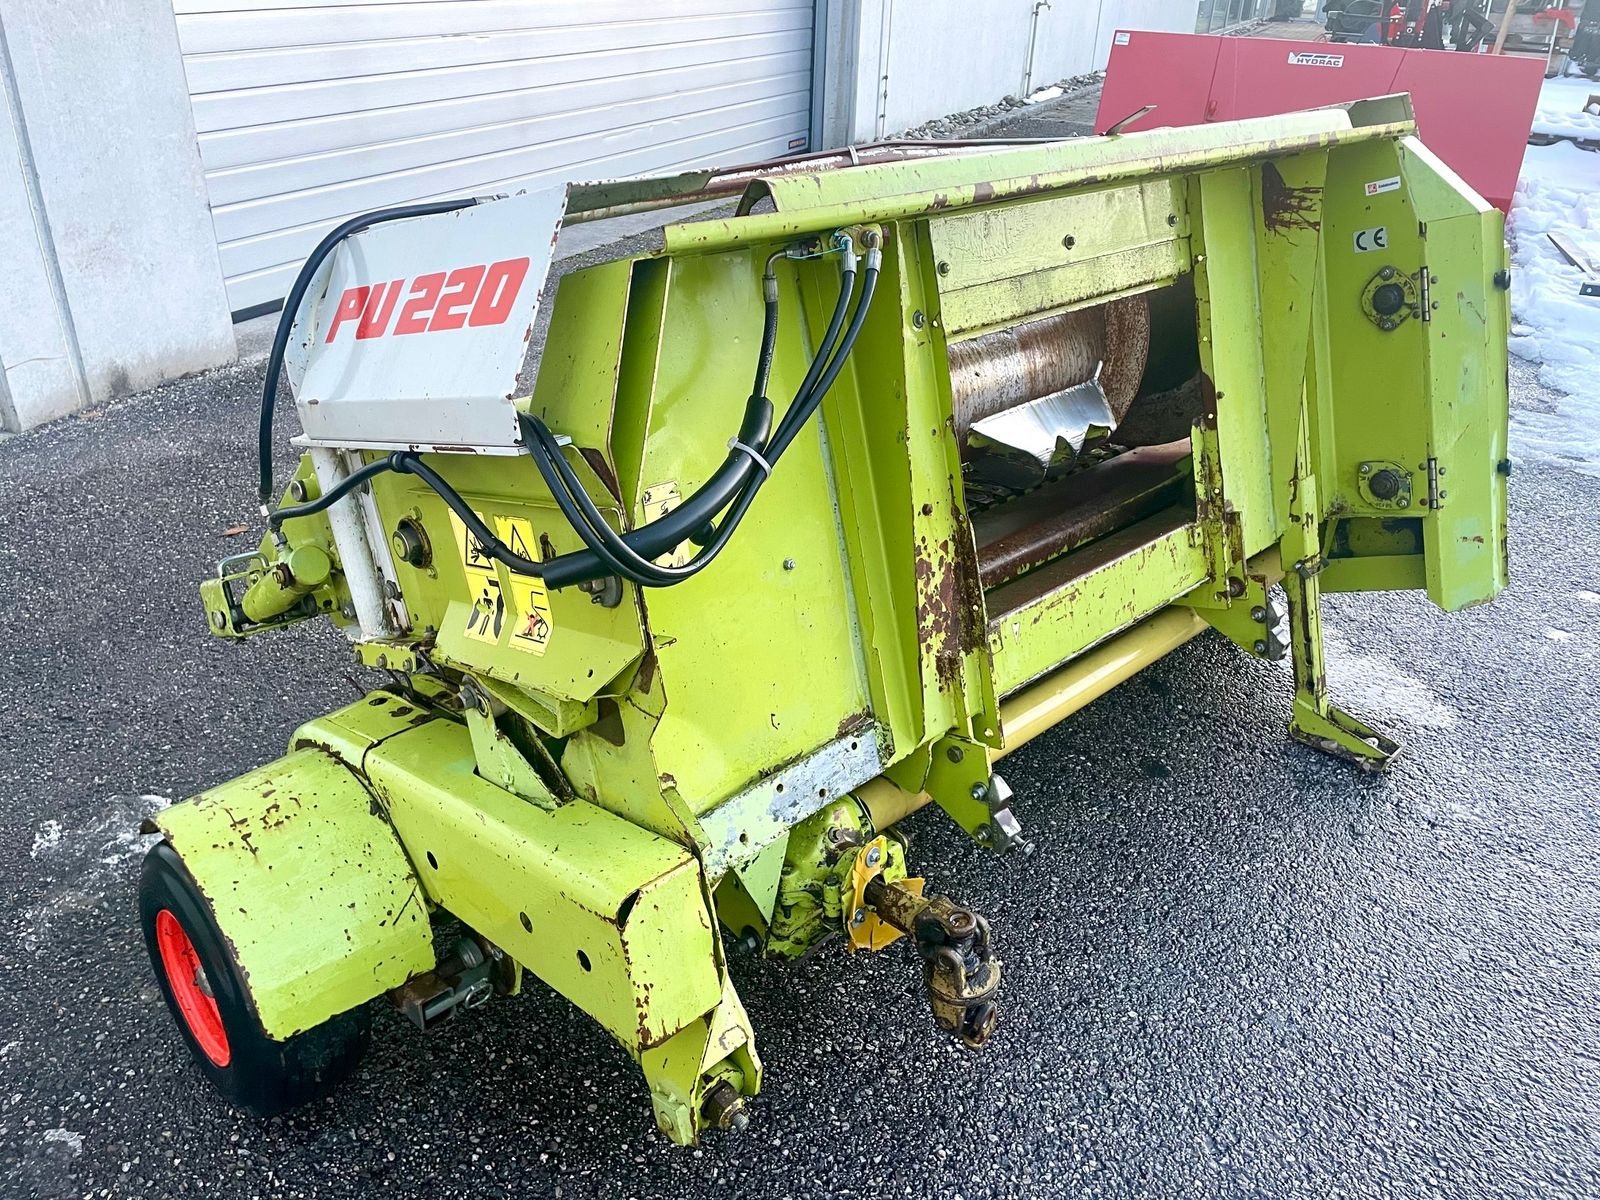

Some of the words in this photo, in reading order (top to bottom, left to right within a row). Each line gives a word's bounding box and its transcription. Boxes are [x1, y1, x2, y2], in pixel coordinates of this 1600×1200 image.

[1296, 57, 1340, 66] HYDRAC
[1356, 227, 1385, 251] CE
[325, 278, 405, 344] PU
[393, 257, 530, 336] 220
